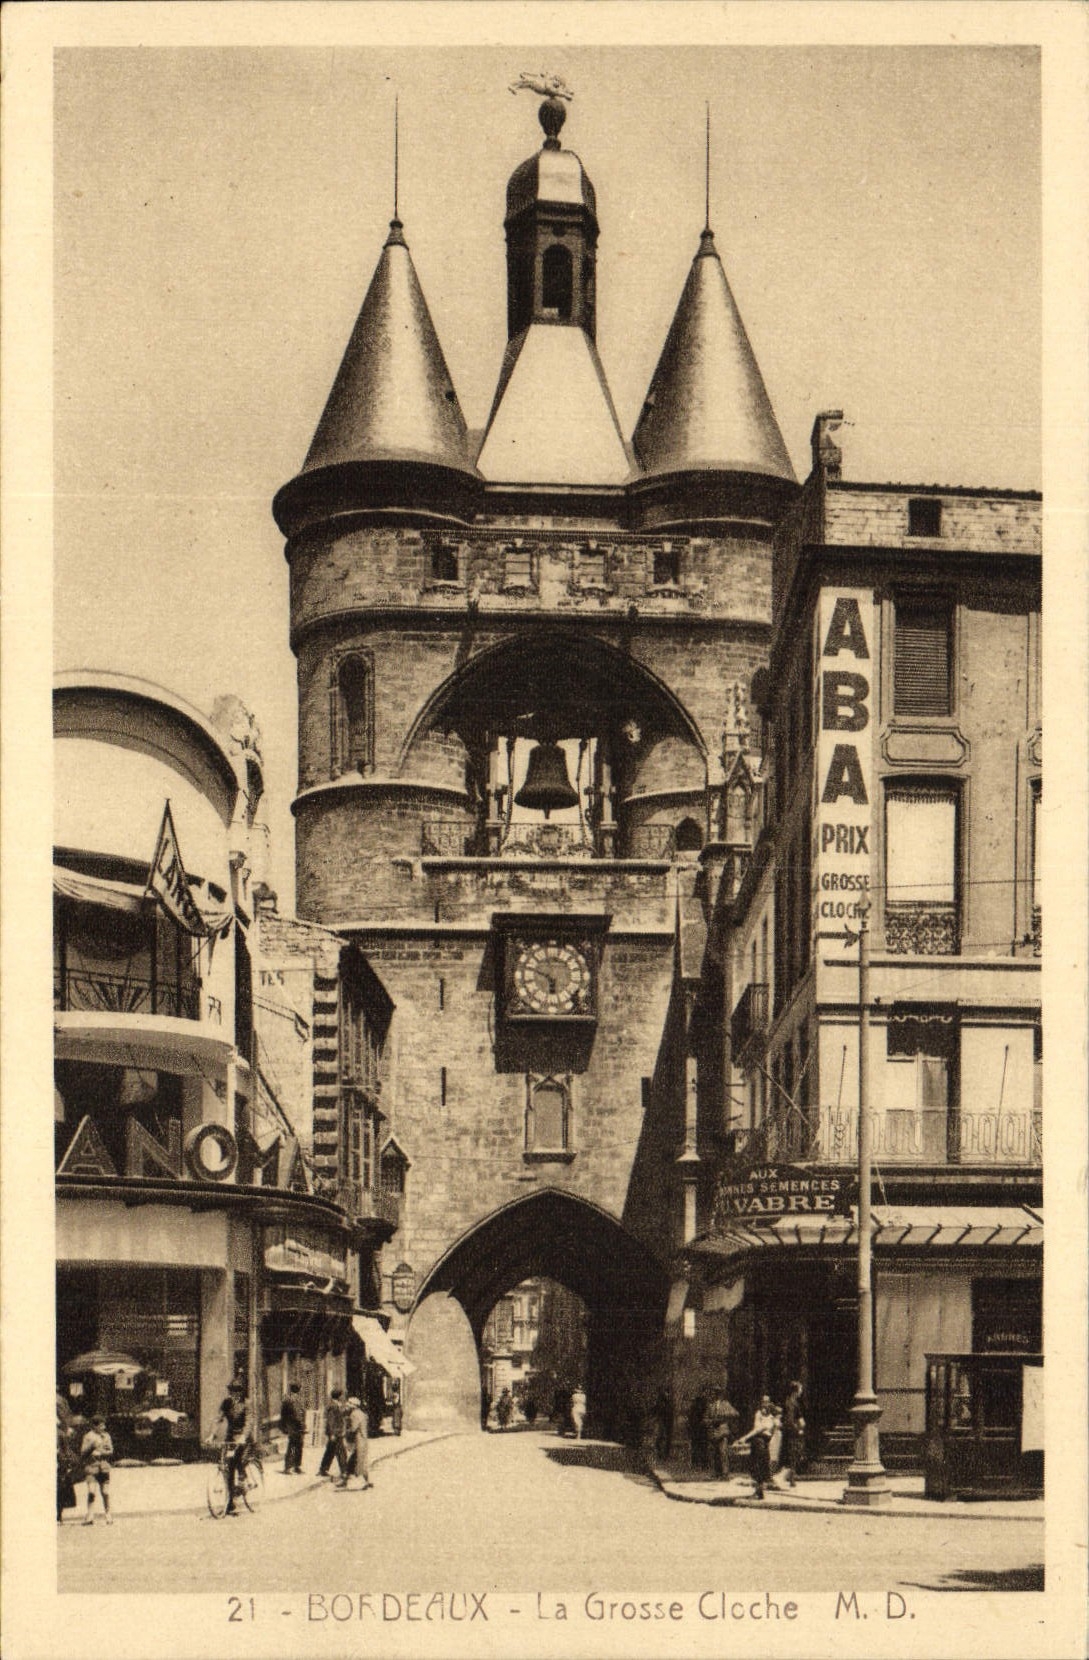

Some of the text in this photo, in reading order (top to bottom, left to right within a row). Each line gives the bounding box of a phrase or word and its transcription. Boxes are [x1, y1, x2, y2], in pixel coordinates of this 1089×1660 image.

[821, 823, 869, 855] PRIX
[821, 872, 870, 892] GROSSE
[750, 1168, 778, 1181] AUX
[760, 1179, 840, 1194] SEMENCES
[734, 1195, 835, 1213] VABRE
